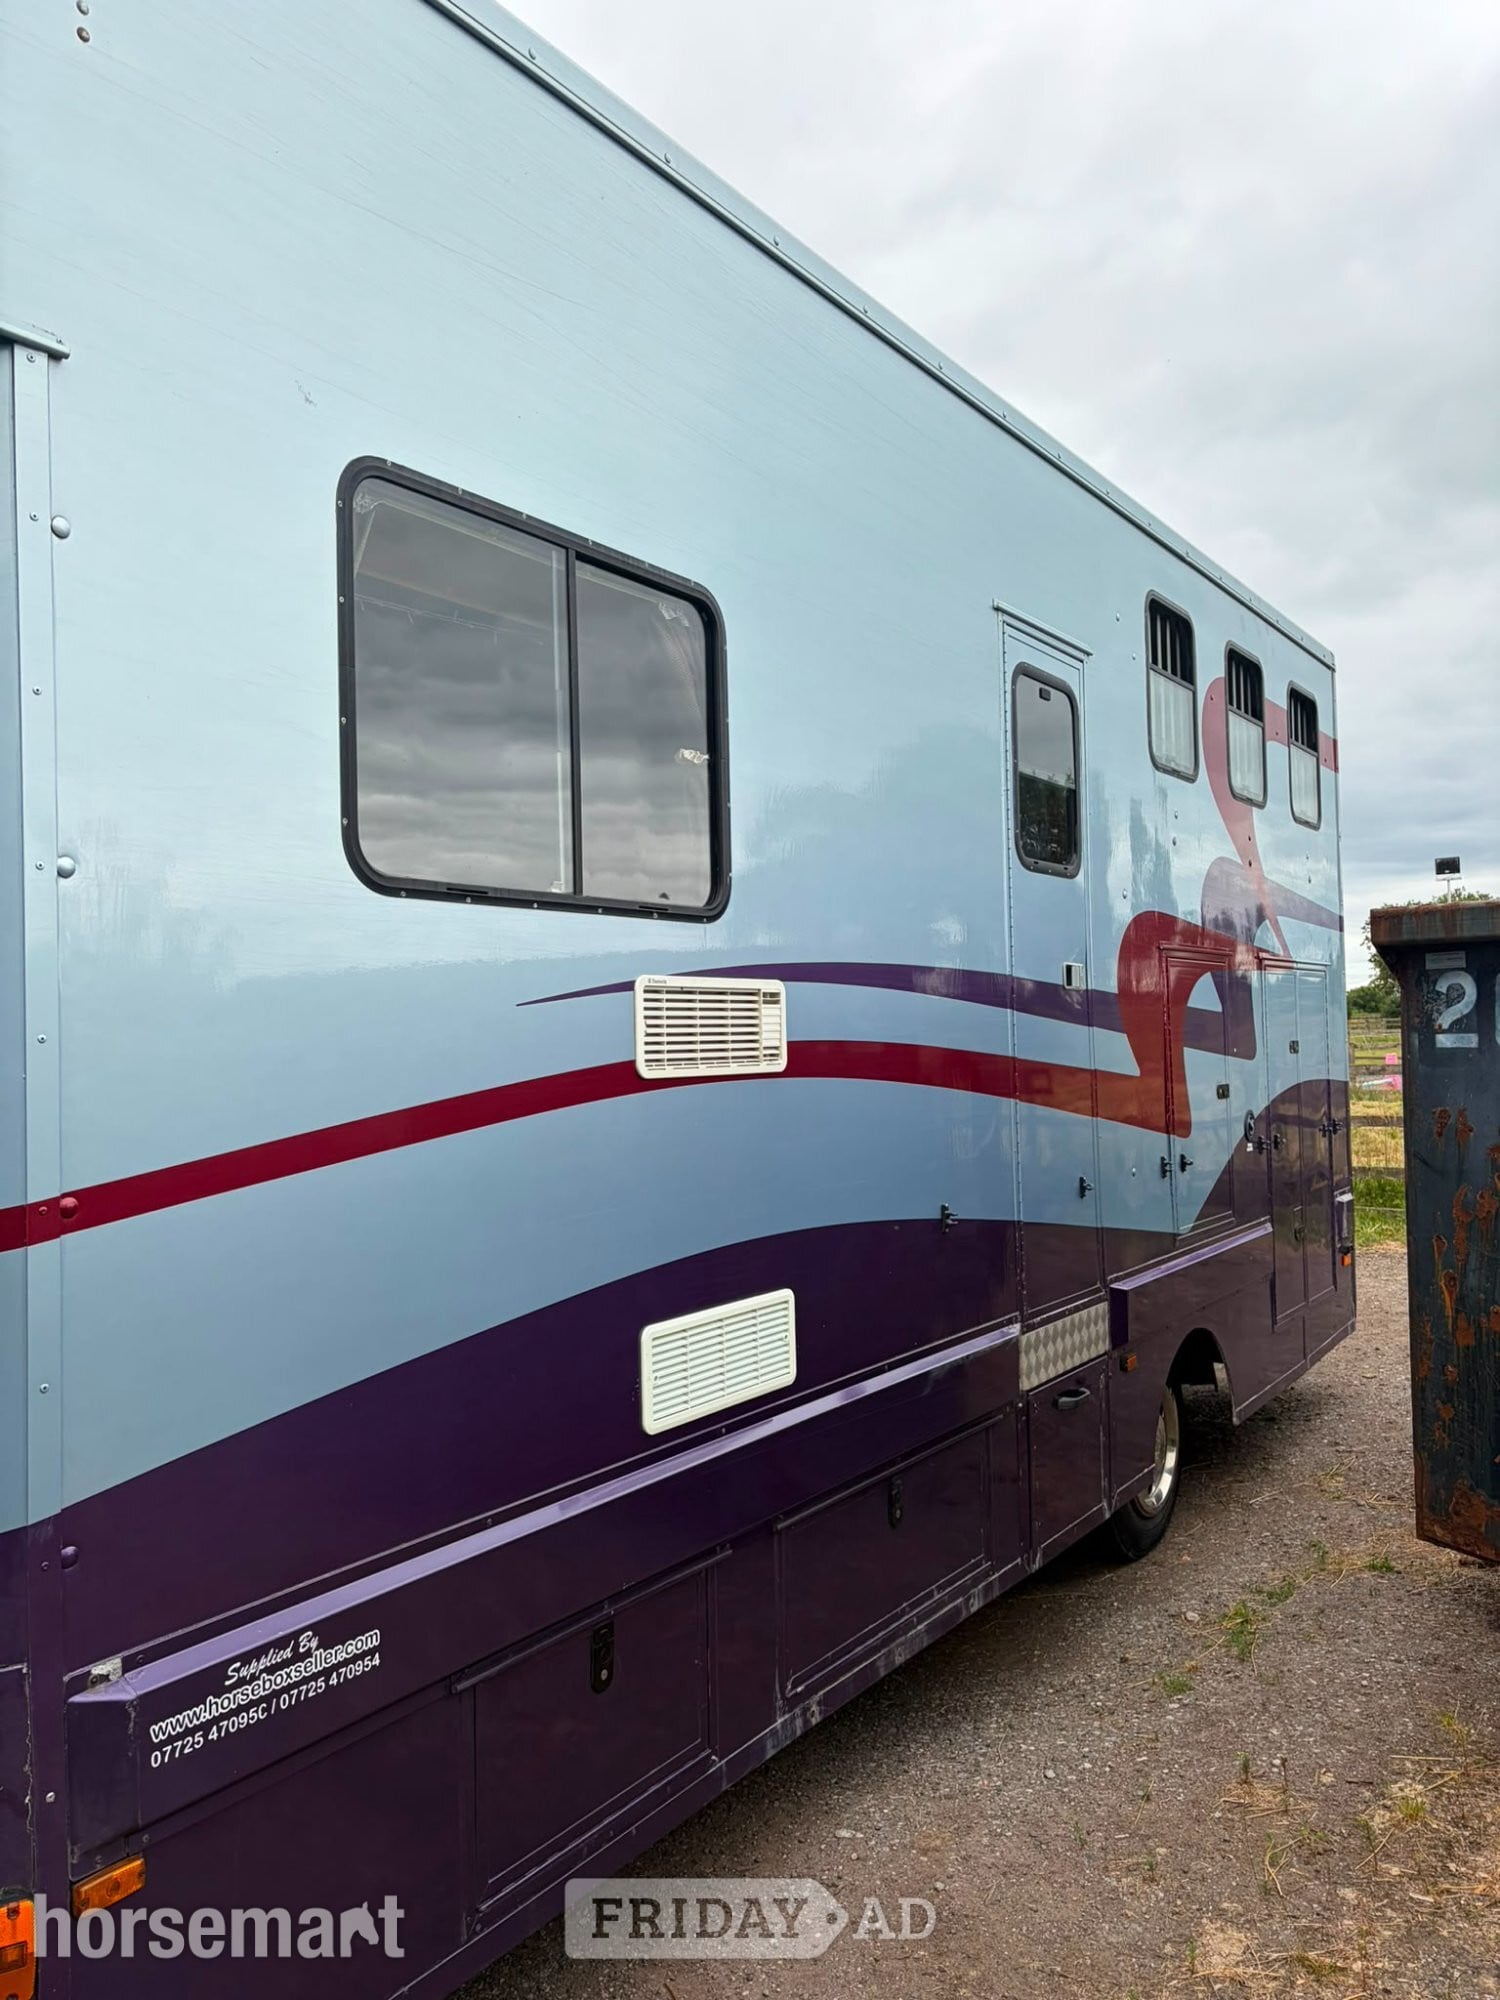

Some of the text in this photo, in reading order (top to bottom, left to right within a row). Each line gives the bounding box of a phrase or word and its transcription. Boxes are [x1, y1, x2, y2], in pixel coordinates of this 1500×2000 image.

[1434, 970, 1500, 1048] 2
[149, 1629, 381, 1743] www.horseboxseller.com
[224, 1631, 319, 1686] Supplied By
[150, 1731, 204, 1768] 07725
[270, 1698, 277, 1714] /
[279, 1677, 325, 1709] 07725
[329, 1652, 381, 1687] 470954
